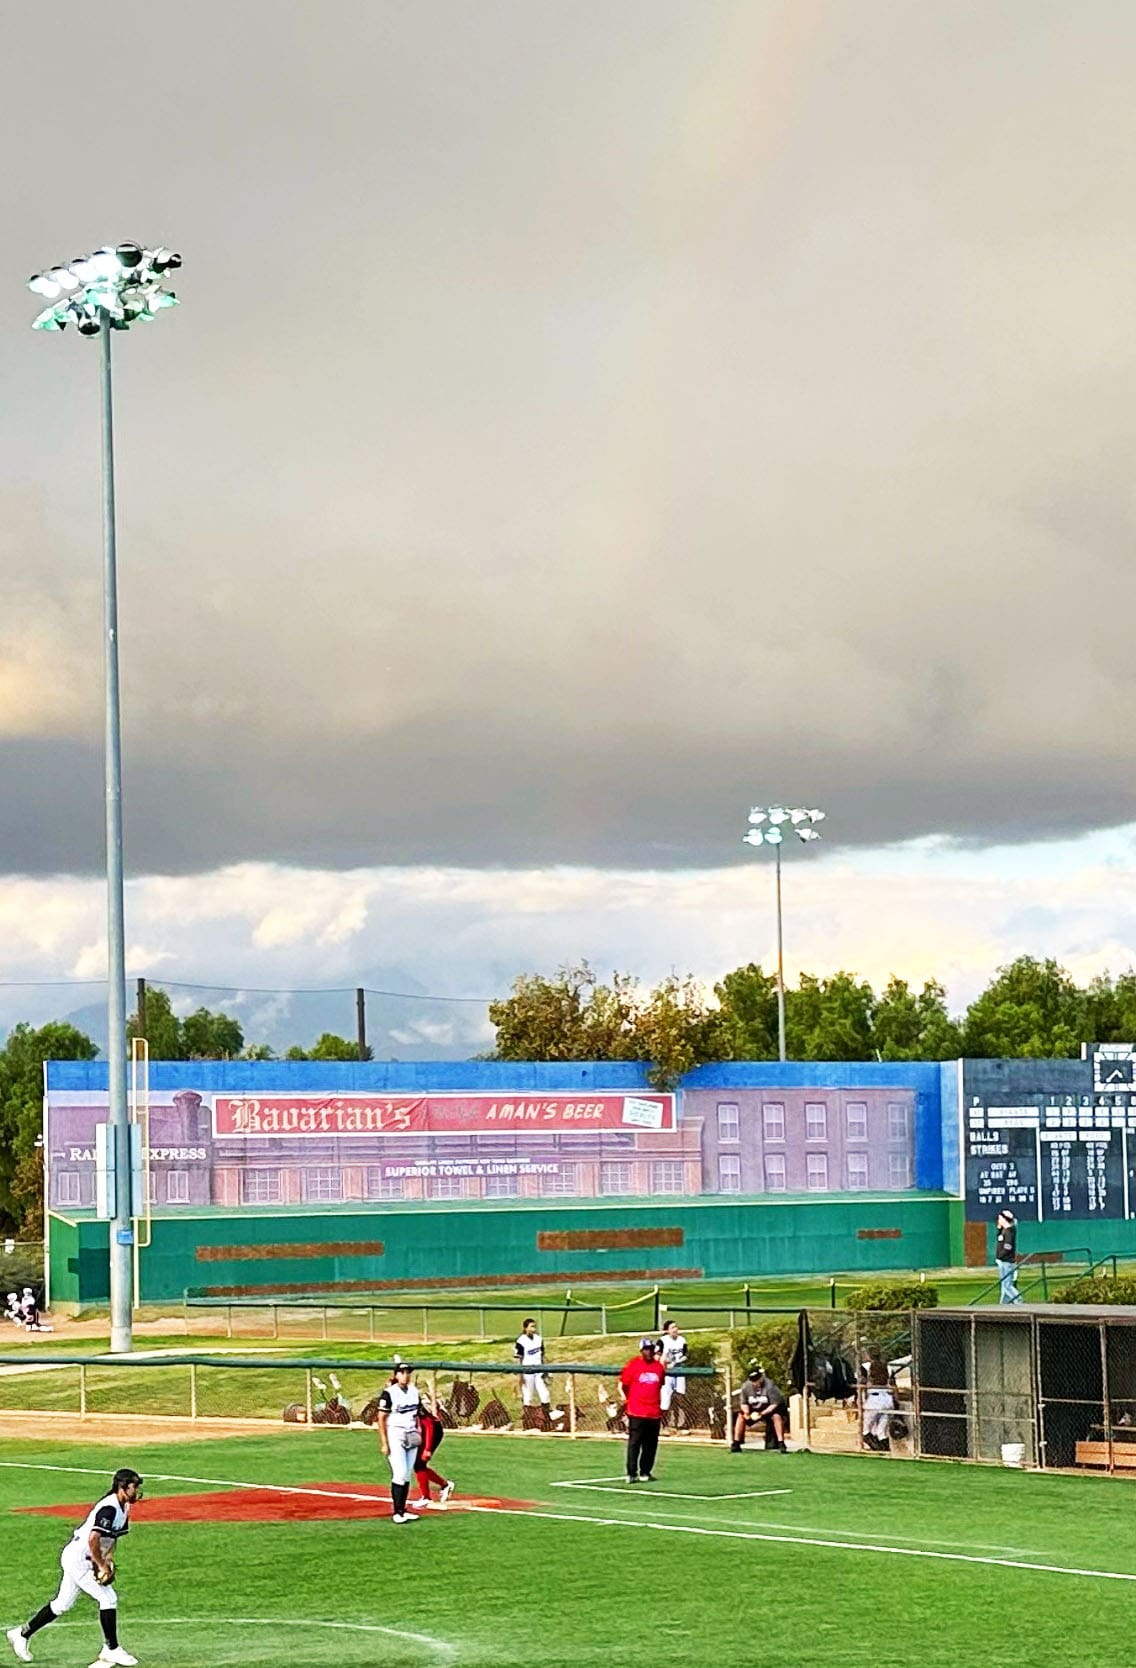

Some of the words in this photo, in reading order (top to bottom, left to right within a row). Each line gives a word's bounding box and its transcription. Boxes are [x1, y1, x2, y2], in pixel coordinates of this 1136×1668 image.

[972, 1096, 980, 1106] P
[1050, 1096, 1055, 1106] 1
[1065, 1096, 1073, 1106] 2
[1082, 1096, 1089, 1106] 3
[1098, 1096, 1105, 1106] 4
[1114, 1096, 1122, 1106] 5
[228, 1099, 411, 1133] Bavarian's
[562, 1103, 605, 1120] BEER
[969, 1131, 999, 1142] BALLS
[970, 1144, 1008, 1155] STRIKES
[385, 1166, 437, 1177] SUPERIOR
[438, 1165, 475, 1176] TOWEL
[476, 1164, 485, 1175] &
[486, 1164, 518, 1175] LINEN
[519, 1163, 559, 1174] SERVICE
[980, 1170, 989, 1179] AT
[990, 1170, 1003, 1179] BAT
